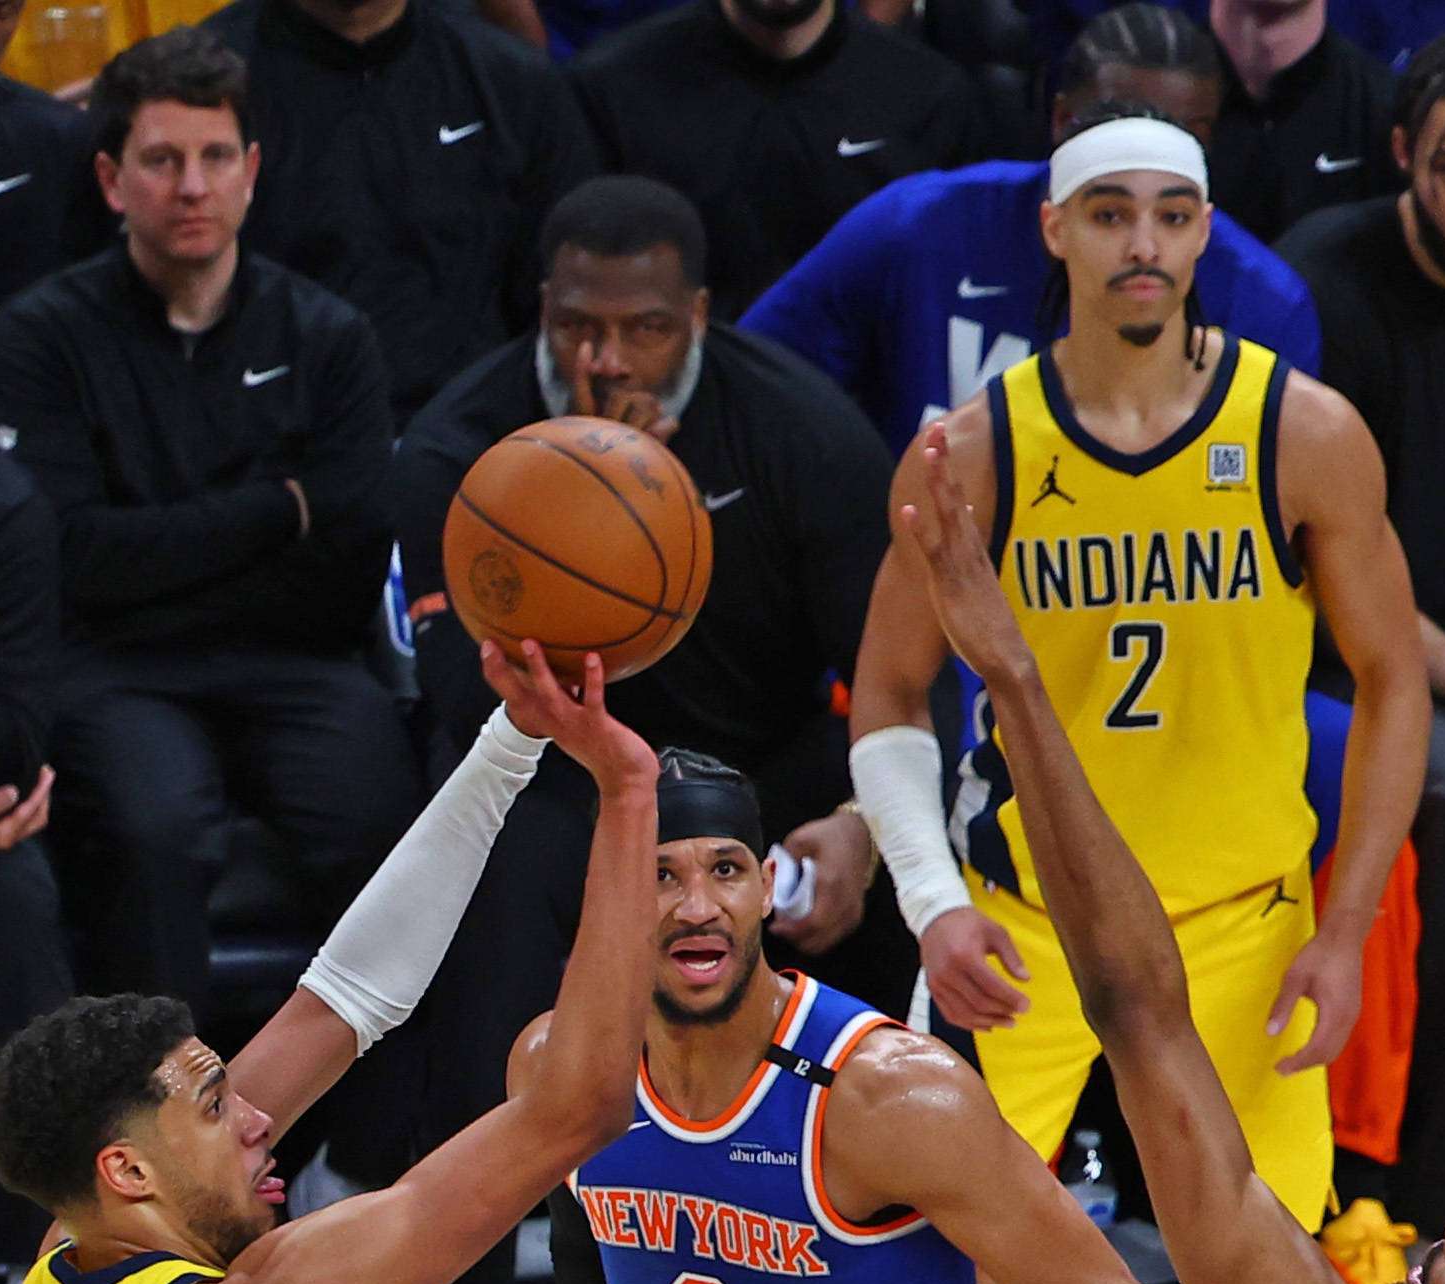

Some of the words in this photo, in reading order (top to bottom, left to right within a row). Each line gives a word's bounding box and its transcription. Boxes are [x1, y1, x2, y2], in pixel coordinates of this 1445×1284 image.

[1013, 527, 1263, 612] INDIANA
[1104, 619, 1167, 732] 2
[794, 1058, 811, 1077] 12
[579, 1185, 679, 1253] NEW
[680, 1195, 831, 1278] YORK
